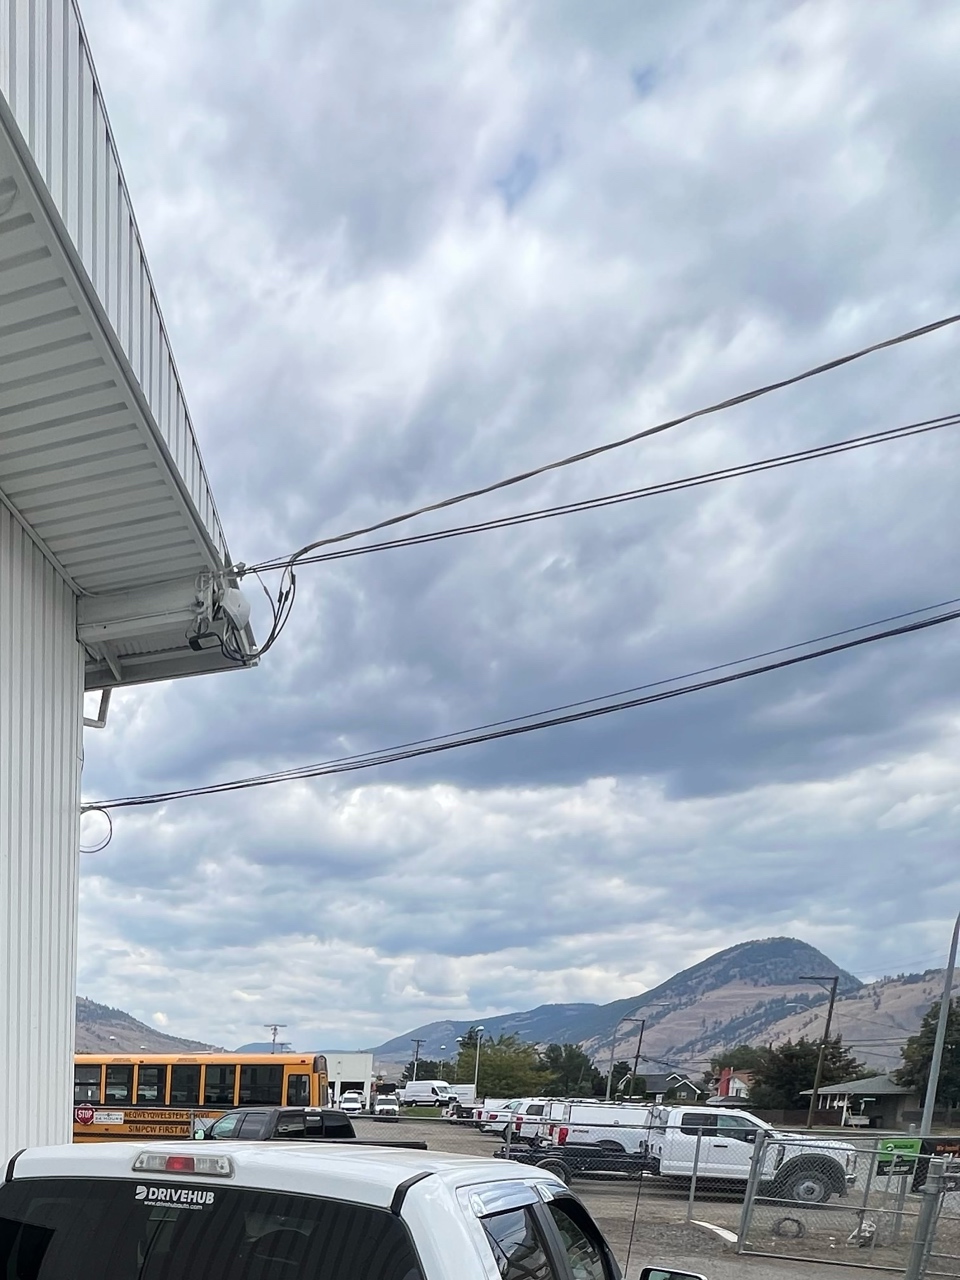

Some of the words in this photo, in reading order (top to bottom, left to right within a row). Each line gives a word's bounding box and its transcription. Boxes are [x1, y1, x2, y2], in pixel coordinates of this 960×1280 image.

[78, 1110, 93, 1118] STOP
[158, 1125, 178, 1134] FIRST
[148, 1187, 215, 1204] DRIVEHUB
